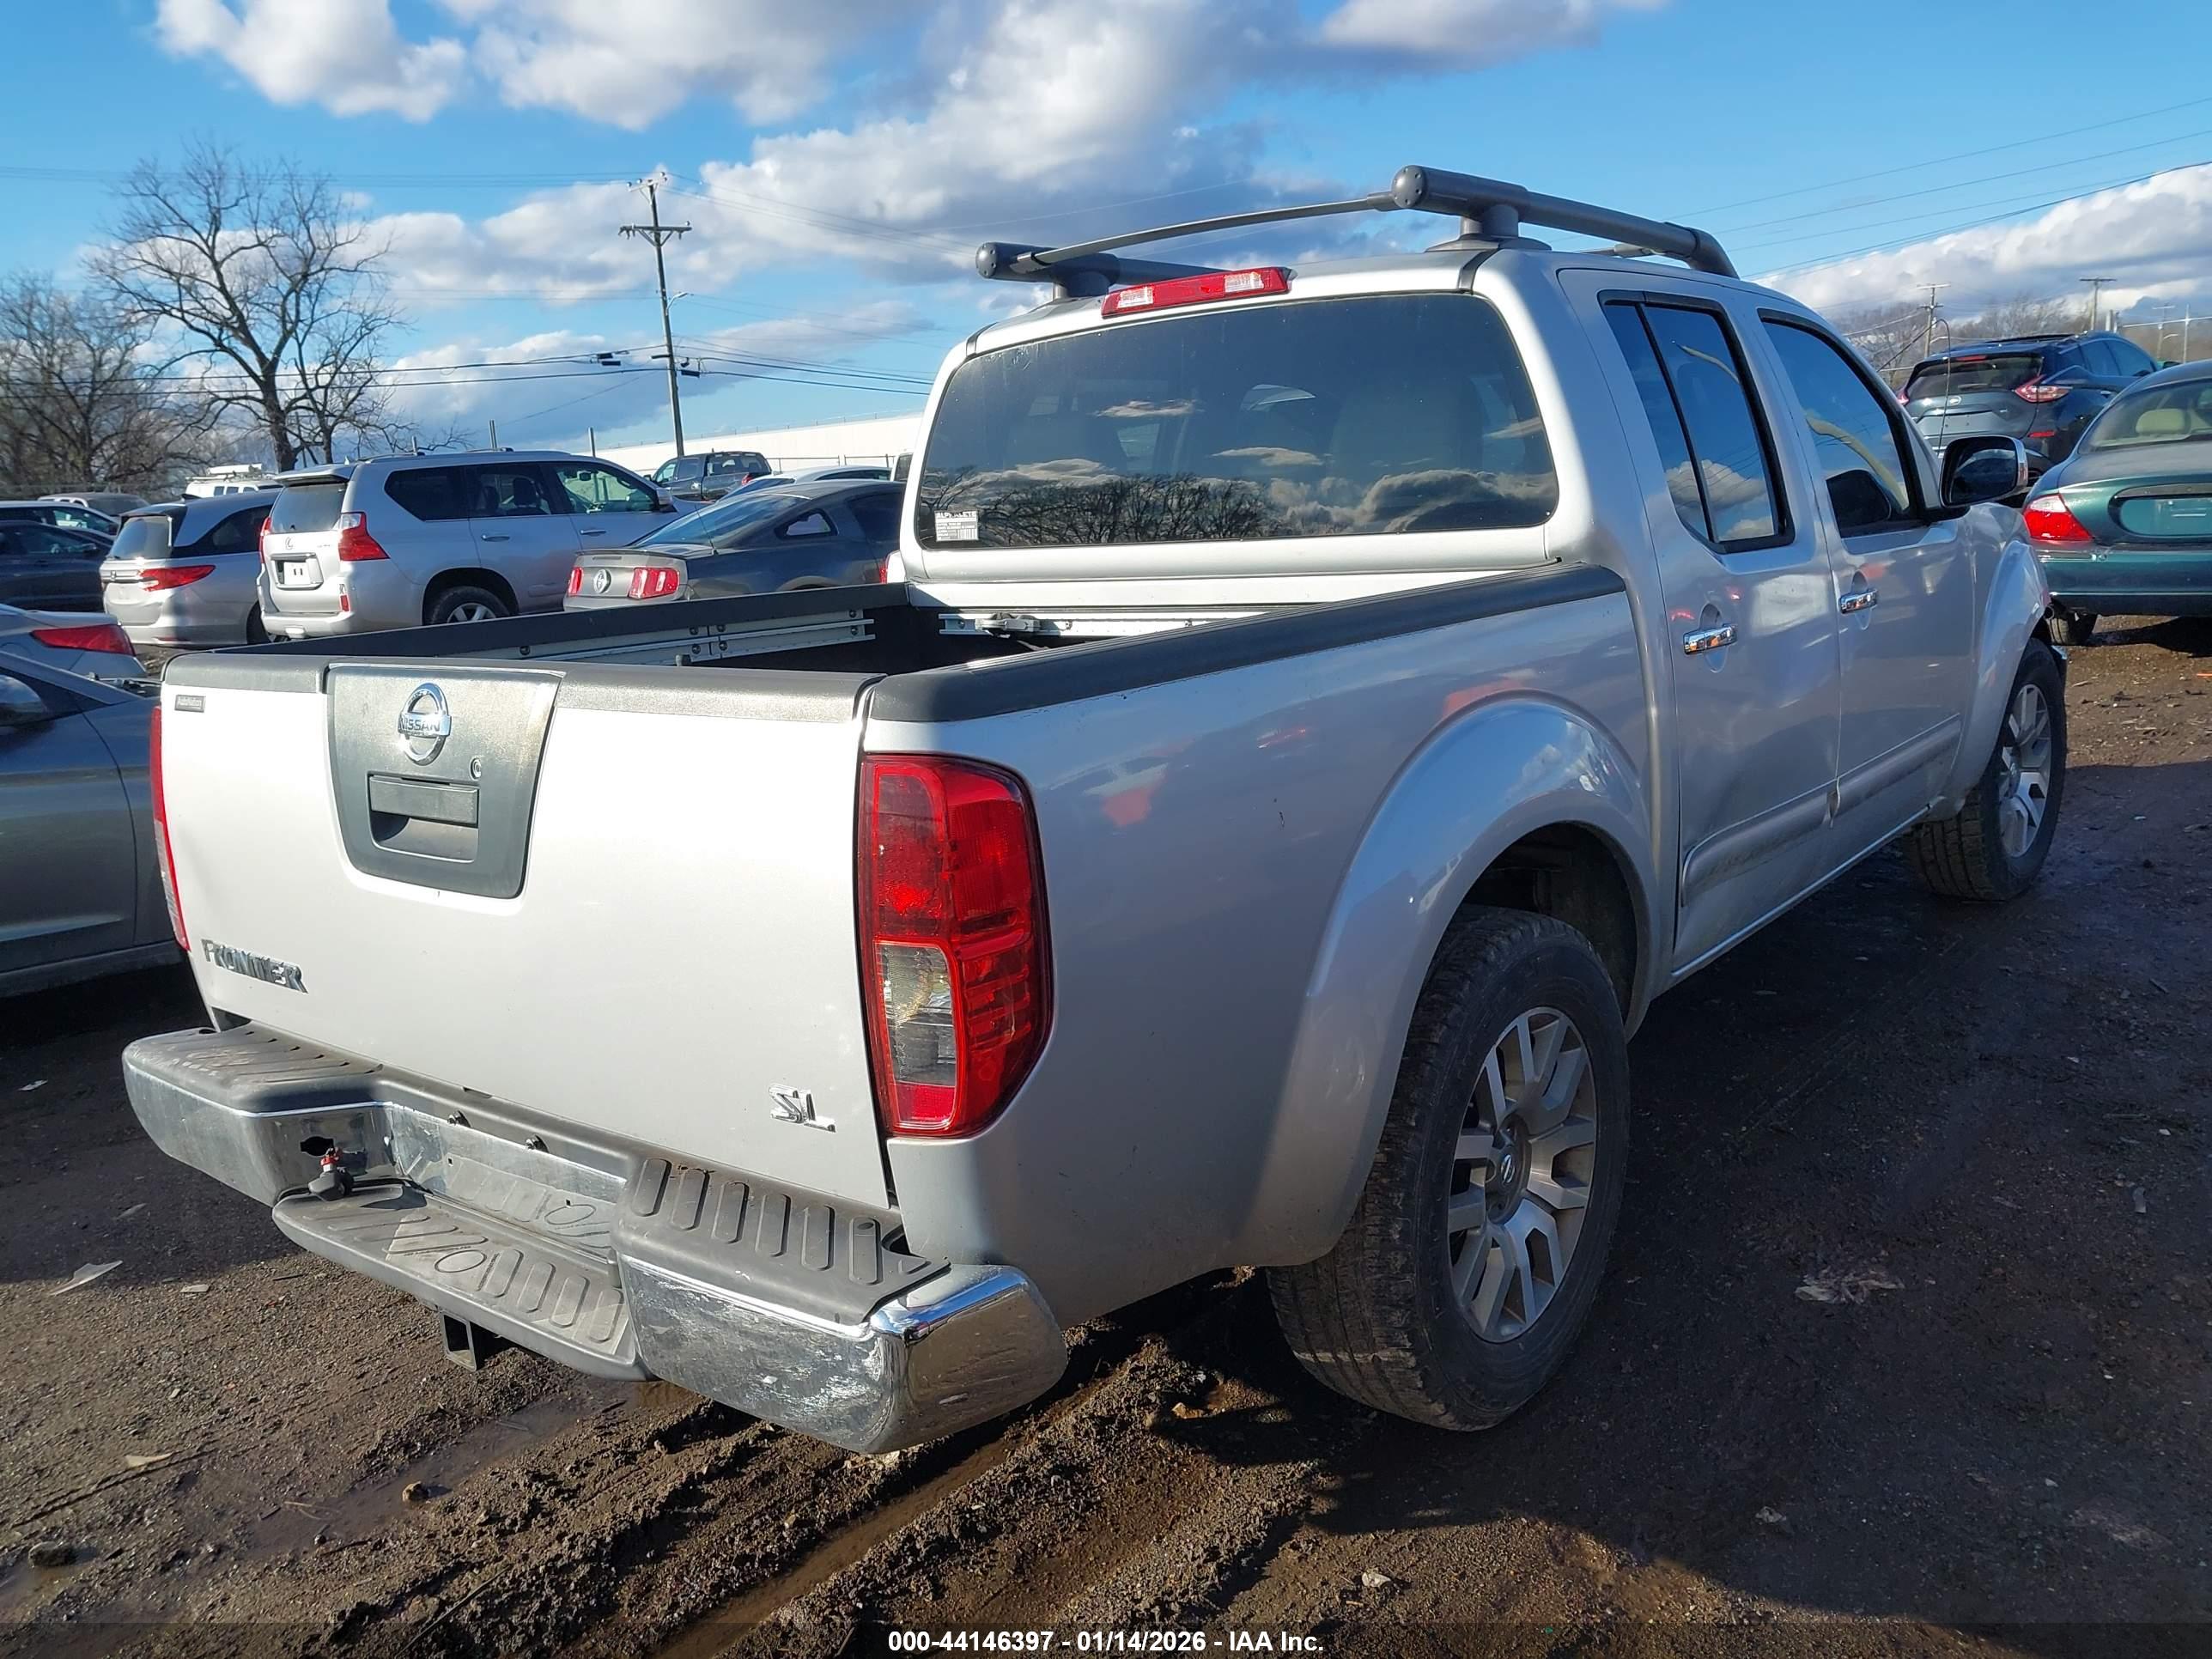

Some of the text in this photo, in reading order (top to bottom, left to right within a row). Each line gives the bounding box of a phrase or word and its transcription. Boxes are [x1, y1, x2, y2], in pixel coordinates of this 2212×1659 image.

[398, 716, 441, 732] NISSAN
[200, 938, 309, 994] FRONTIER
[769, 1083, 836, 1133] SL
